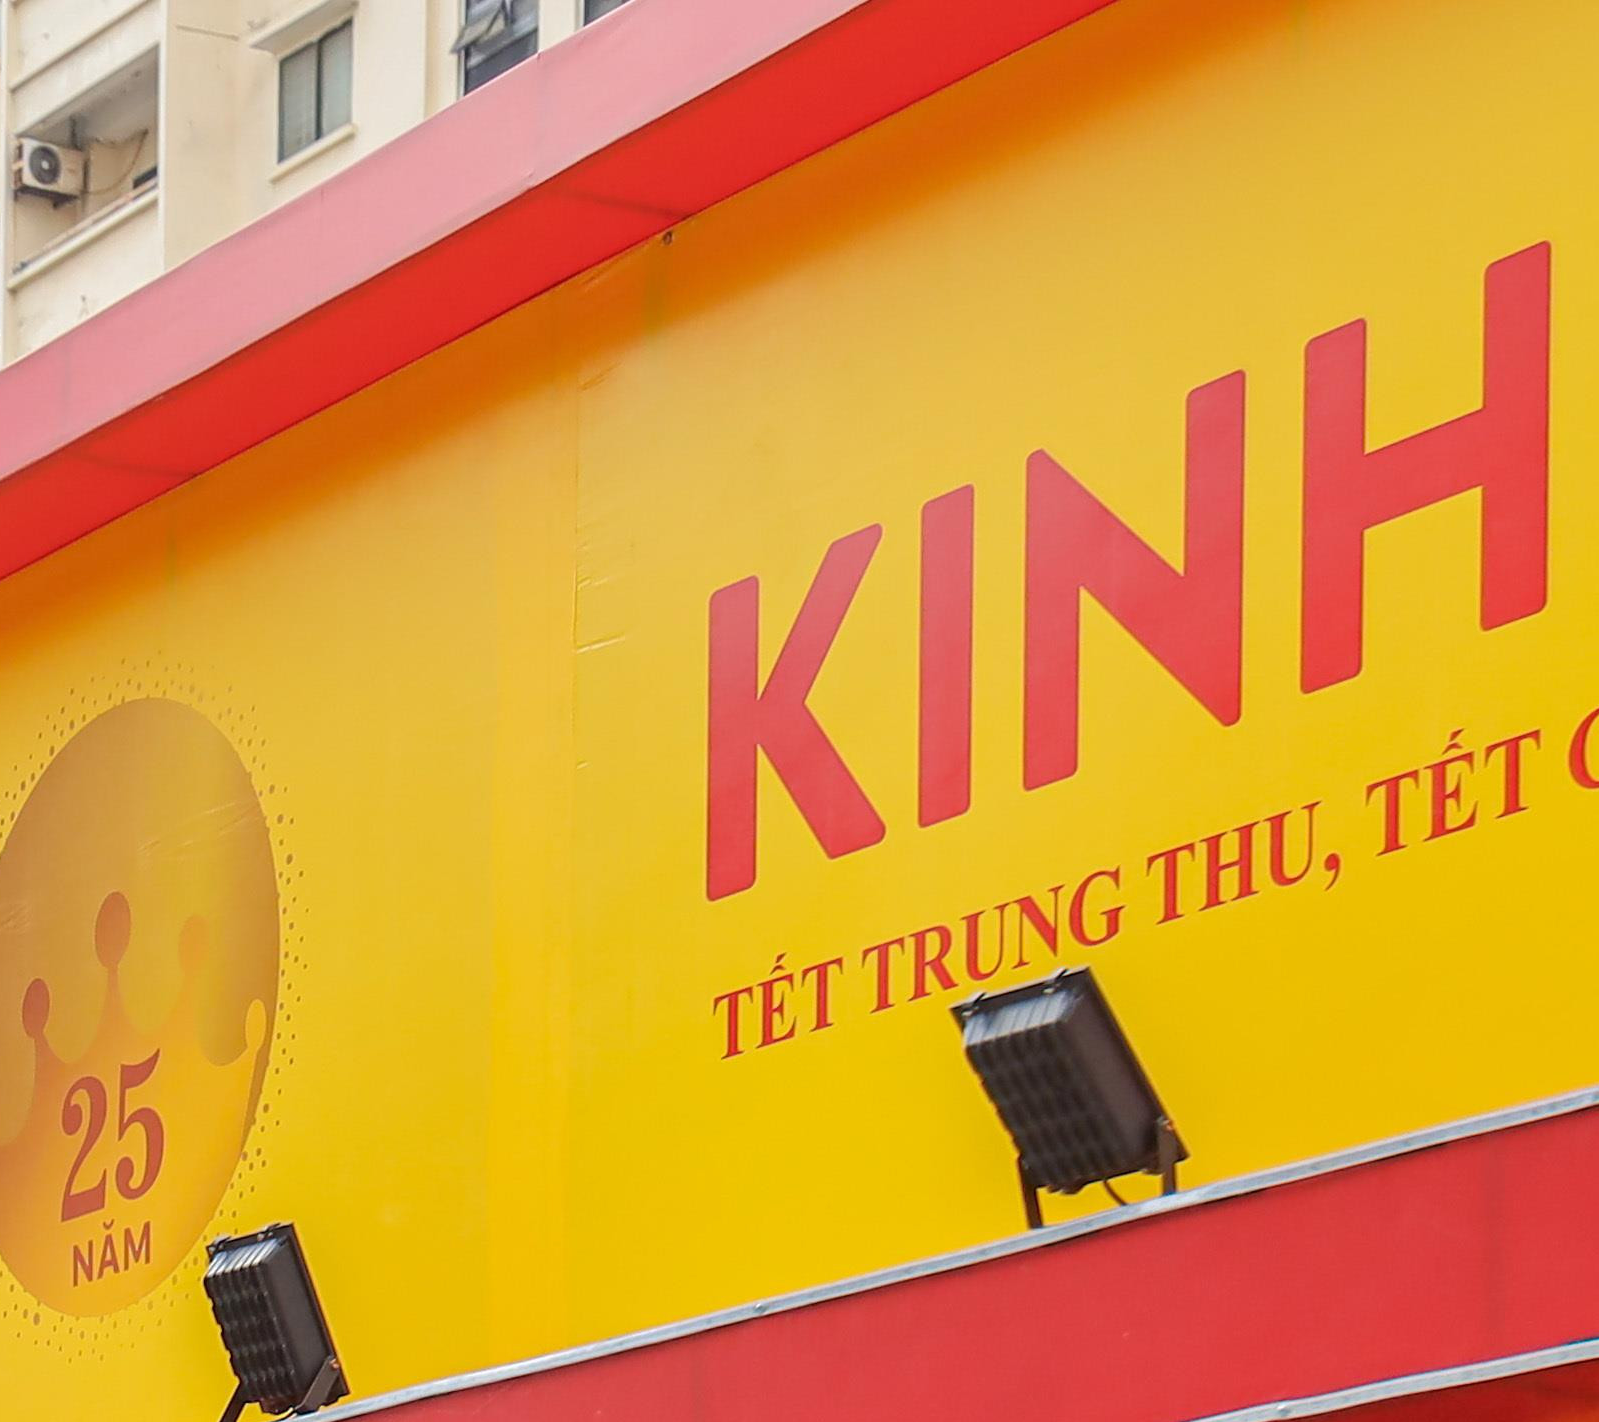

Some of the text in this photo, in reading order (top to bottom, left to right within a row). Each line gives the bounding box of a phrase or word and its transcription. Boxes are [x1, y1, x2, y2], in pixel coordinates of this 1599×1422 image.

[704, 241, 1551, 903] KINH
[713, 950, 848, 1062] TẾT
[862, 869, 1126, 1016] TRUNG
[1146, 802, 1340, 927] THU,
[1367, 722, 1542, 852] TẾT
[60, 1048, 165, 1222] 25
[72, 1219, 152, 1286] NĂM
